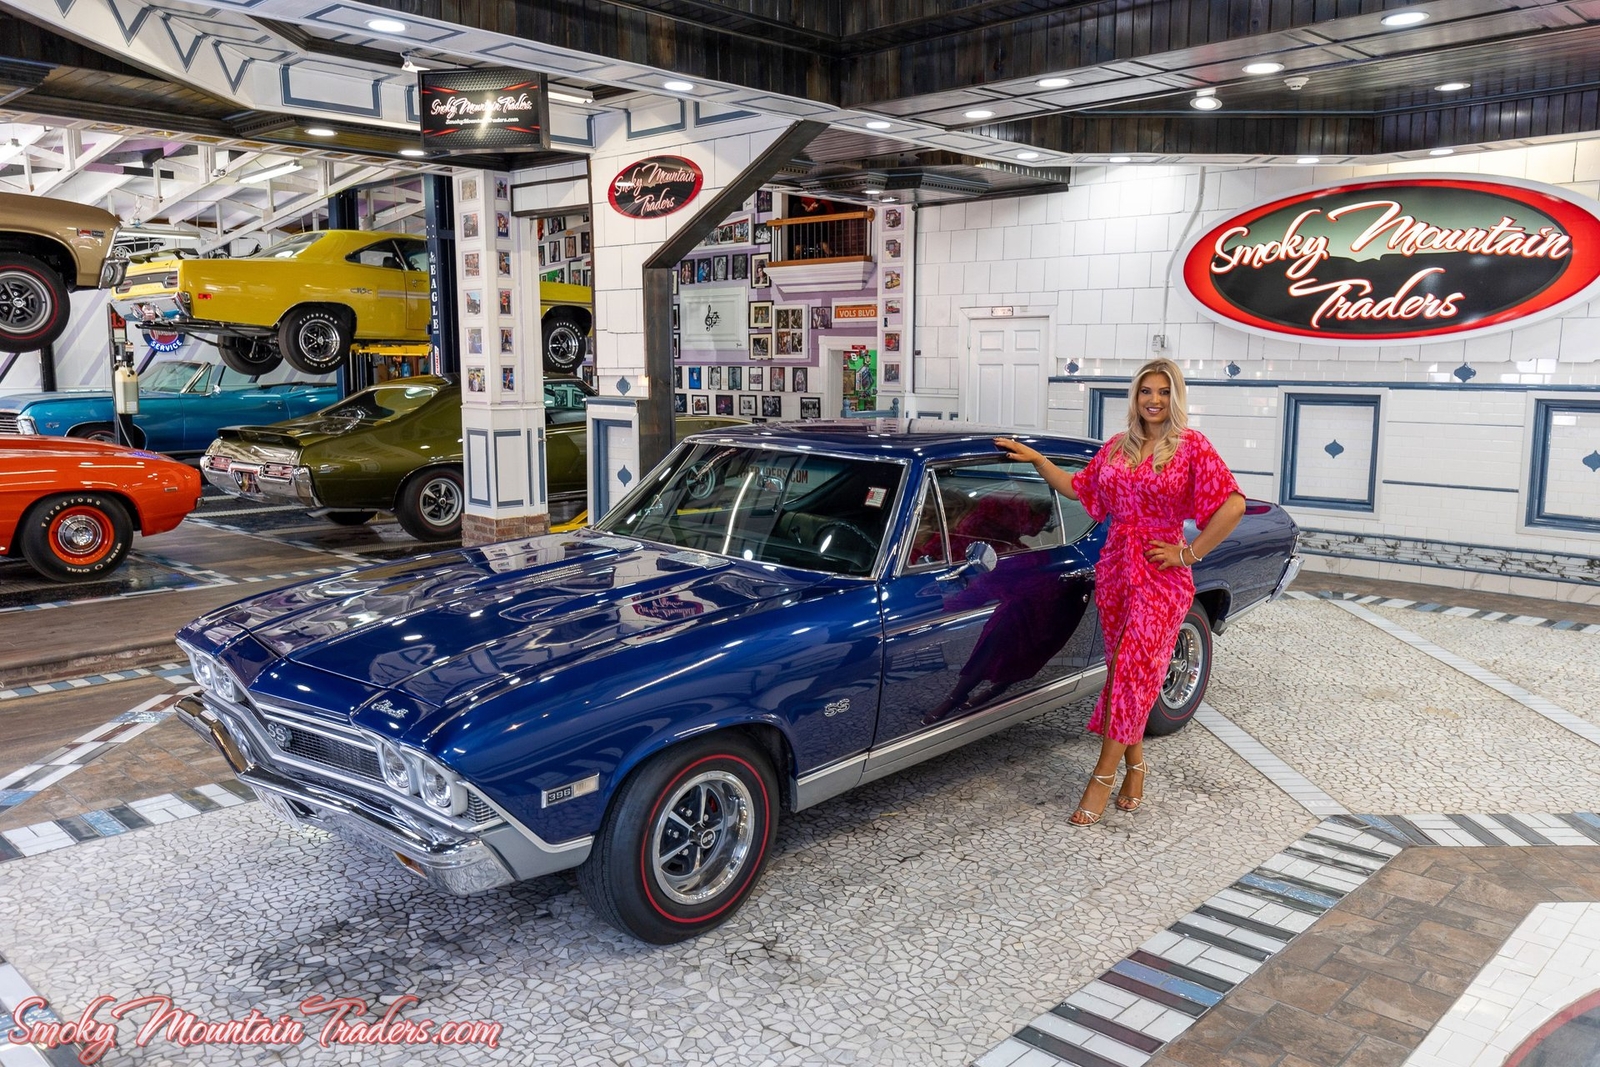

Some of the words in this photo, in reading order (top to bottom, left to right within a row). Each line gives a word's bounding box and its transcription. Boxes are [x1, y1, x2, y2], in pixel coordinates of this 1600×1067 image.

[430, 96, 458, 119] Smoky
[497, 93, 533, 114] Traders
[614, 167, 644, 197] Smoky
[641, 162, 696, 185] Mountain
[634, 187, 676, 217] Traders
[1210, 208, 1330, 280] Smoky
[1327, 200, 1573, 261] Mountain
[430, 264, 440, 330] EAGLE
[1288, 267, 1466, 329] Traders
[839, 310, 857, 318] VOLS
[857, 309, 876, 317] BLVD
[150, 340, 183, 353] SERVICE
[824, 698, 850, 717] SS
[267, 722, 286, 742] SS
[548, 788, 571, 802] 396
